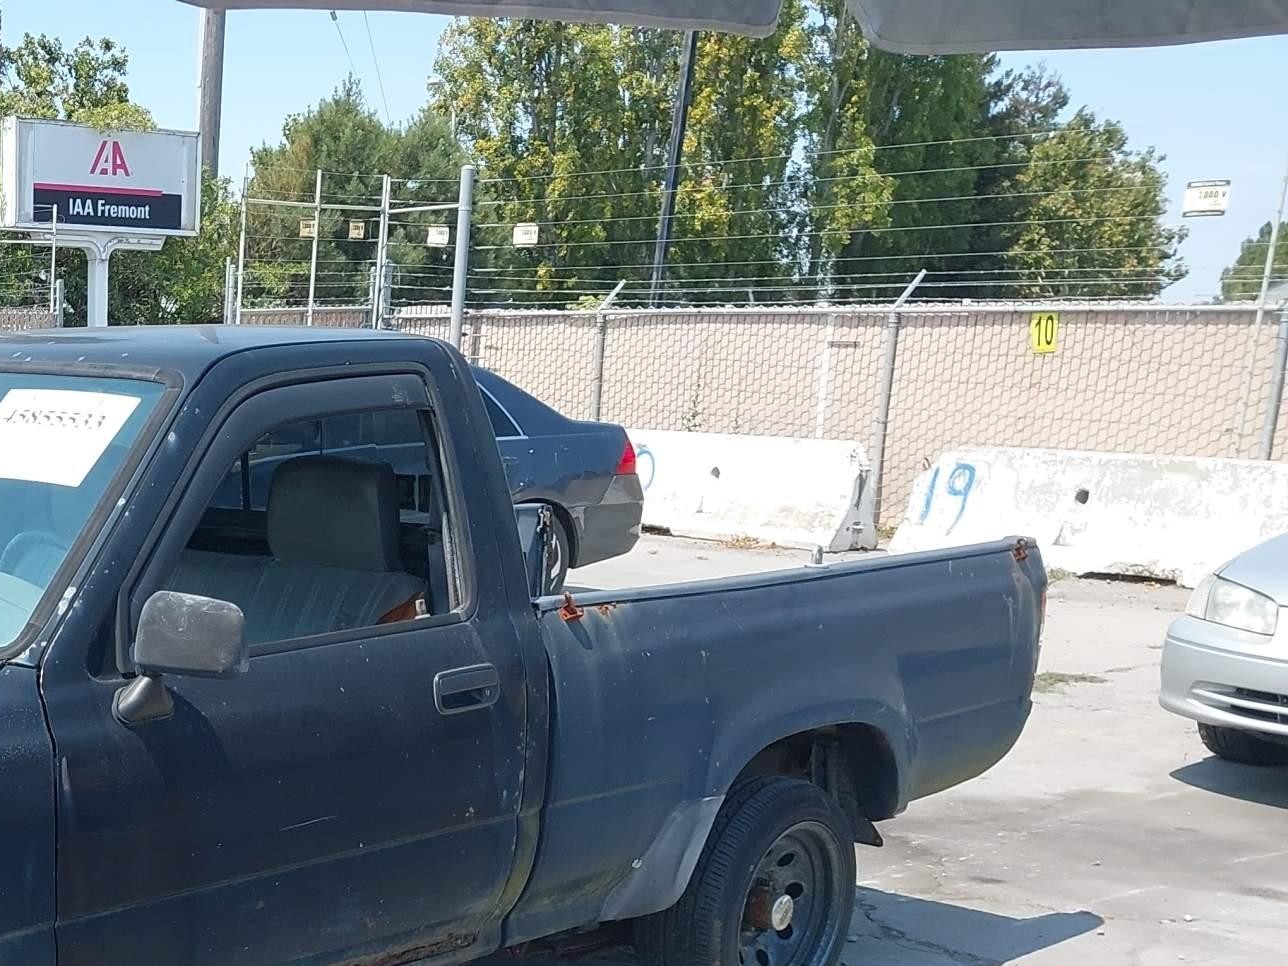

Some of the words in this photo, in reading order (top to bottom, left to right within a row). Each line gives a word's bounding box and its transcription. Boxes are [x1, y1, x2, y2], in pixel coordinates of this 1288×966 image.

[69, 198, 94, 216] IAA
[97, 200, 150, 220] Fremont
[1035, 314, 1055, 347] 10
[918, 462, 976, 536] 19
